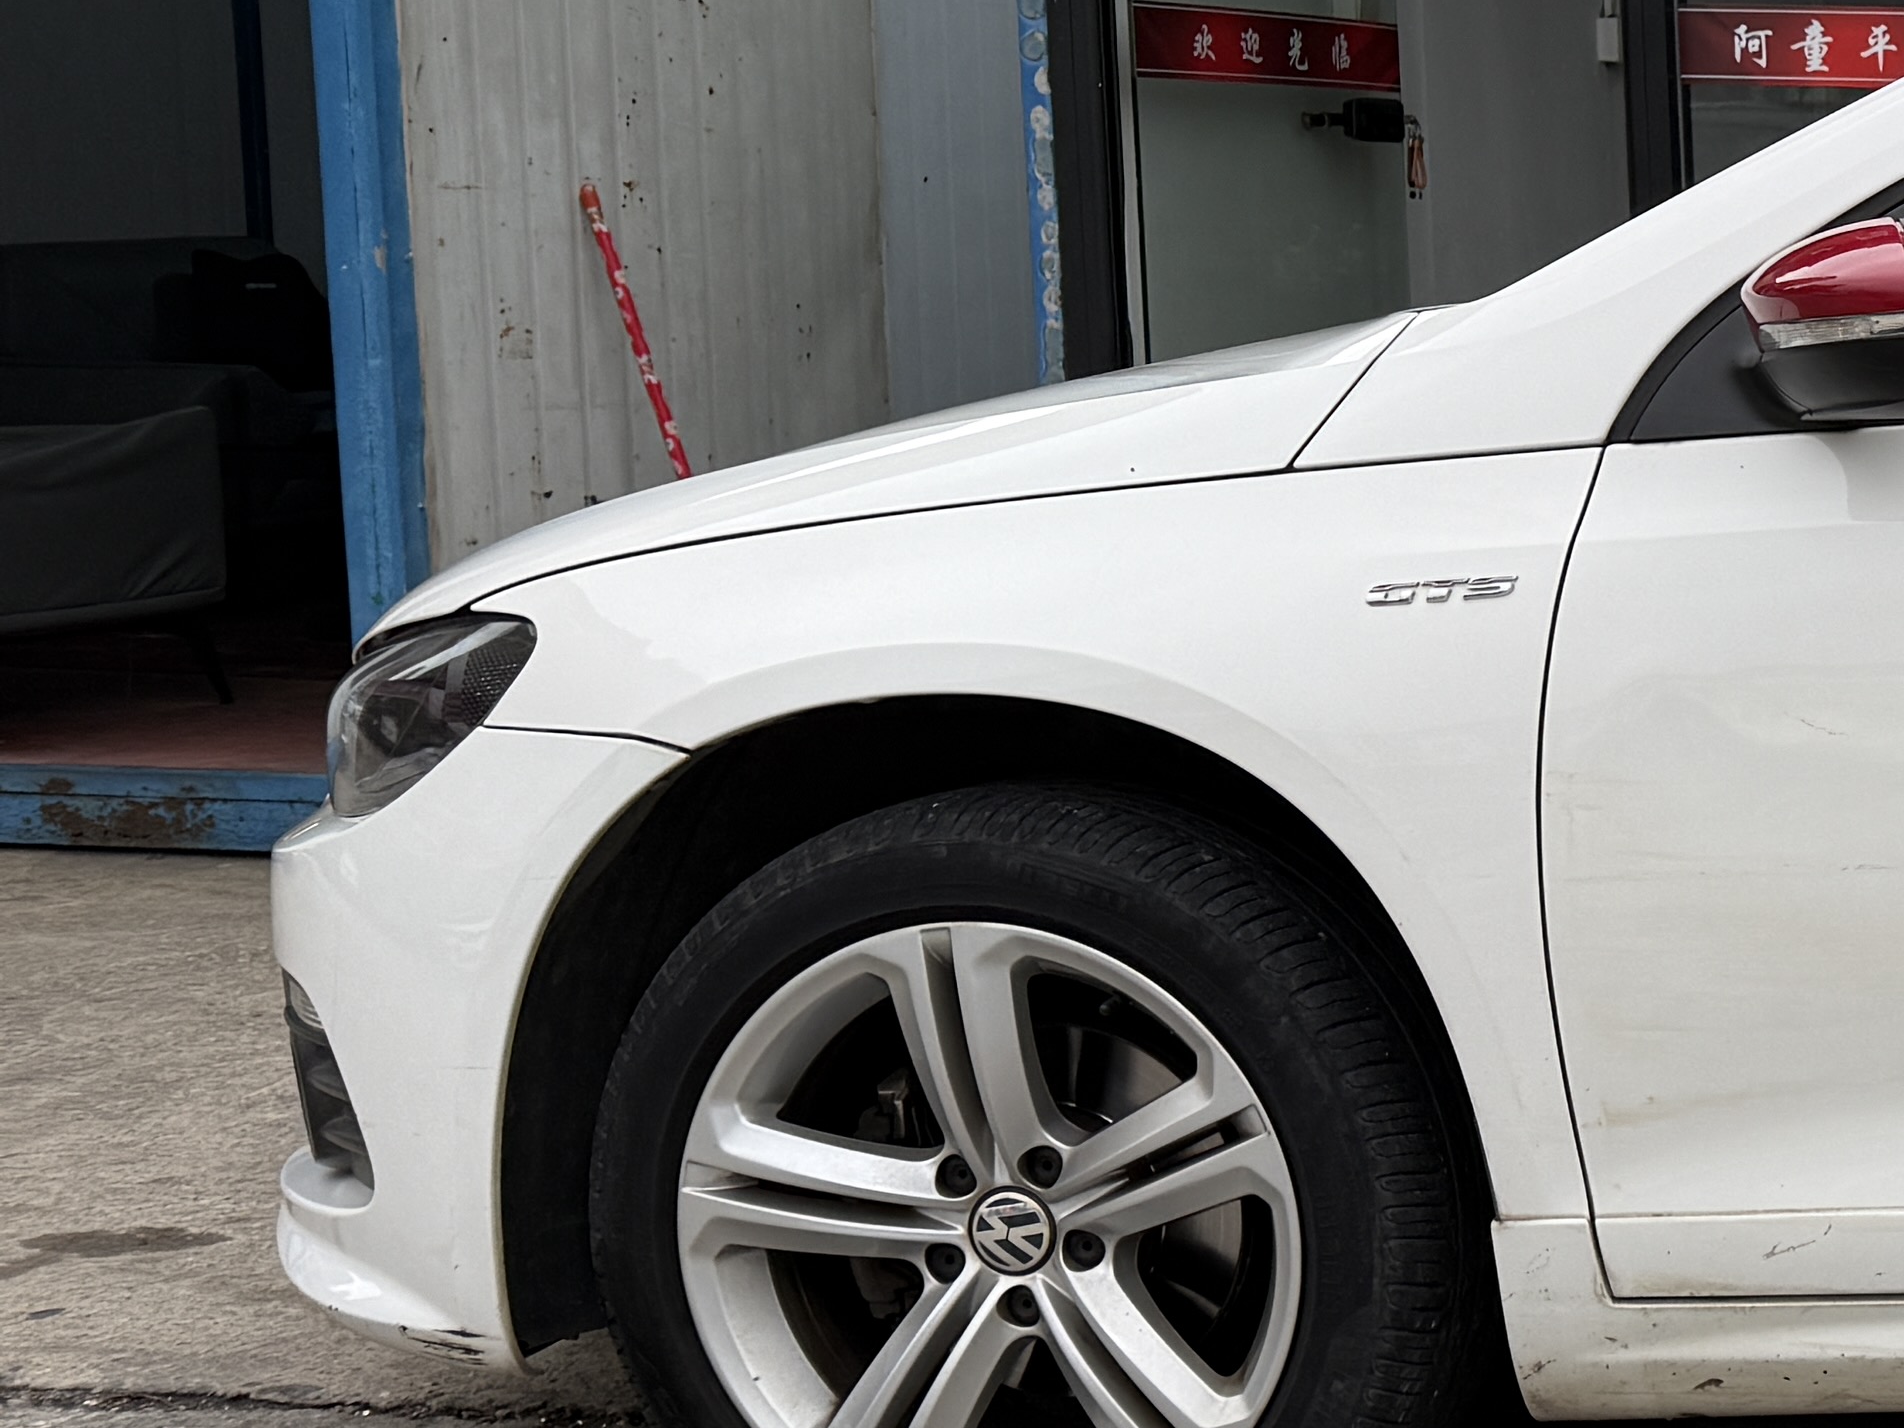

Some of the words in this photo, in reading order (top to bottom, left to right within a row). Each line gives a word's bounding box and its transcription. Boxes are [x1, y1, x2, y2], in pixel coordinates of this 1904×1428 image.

[1193, 24, 1350, 71] 欢迎光临
[1365, 575, 1519, 607] GTS
